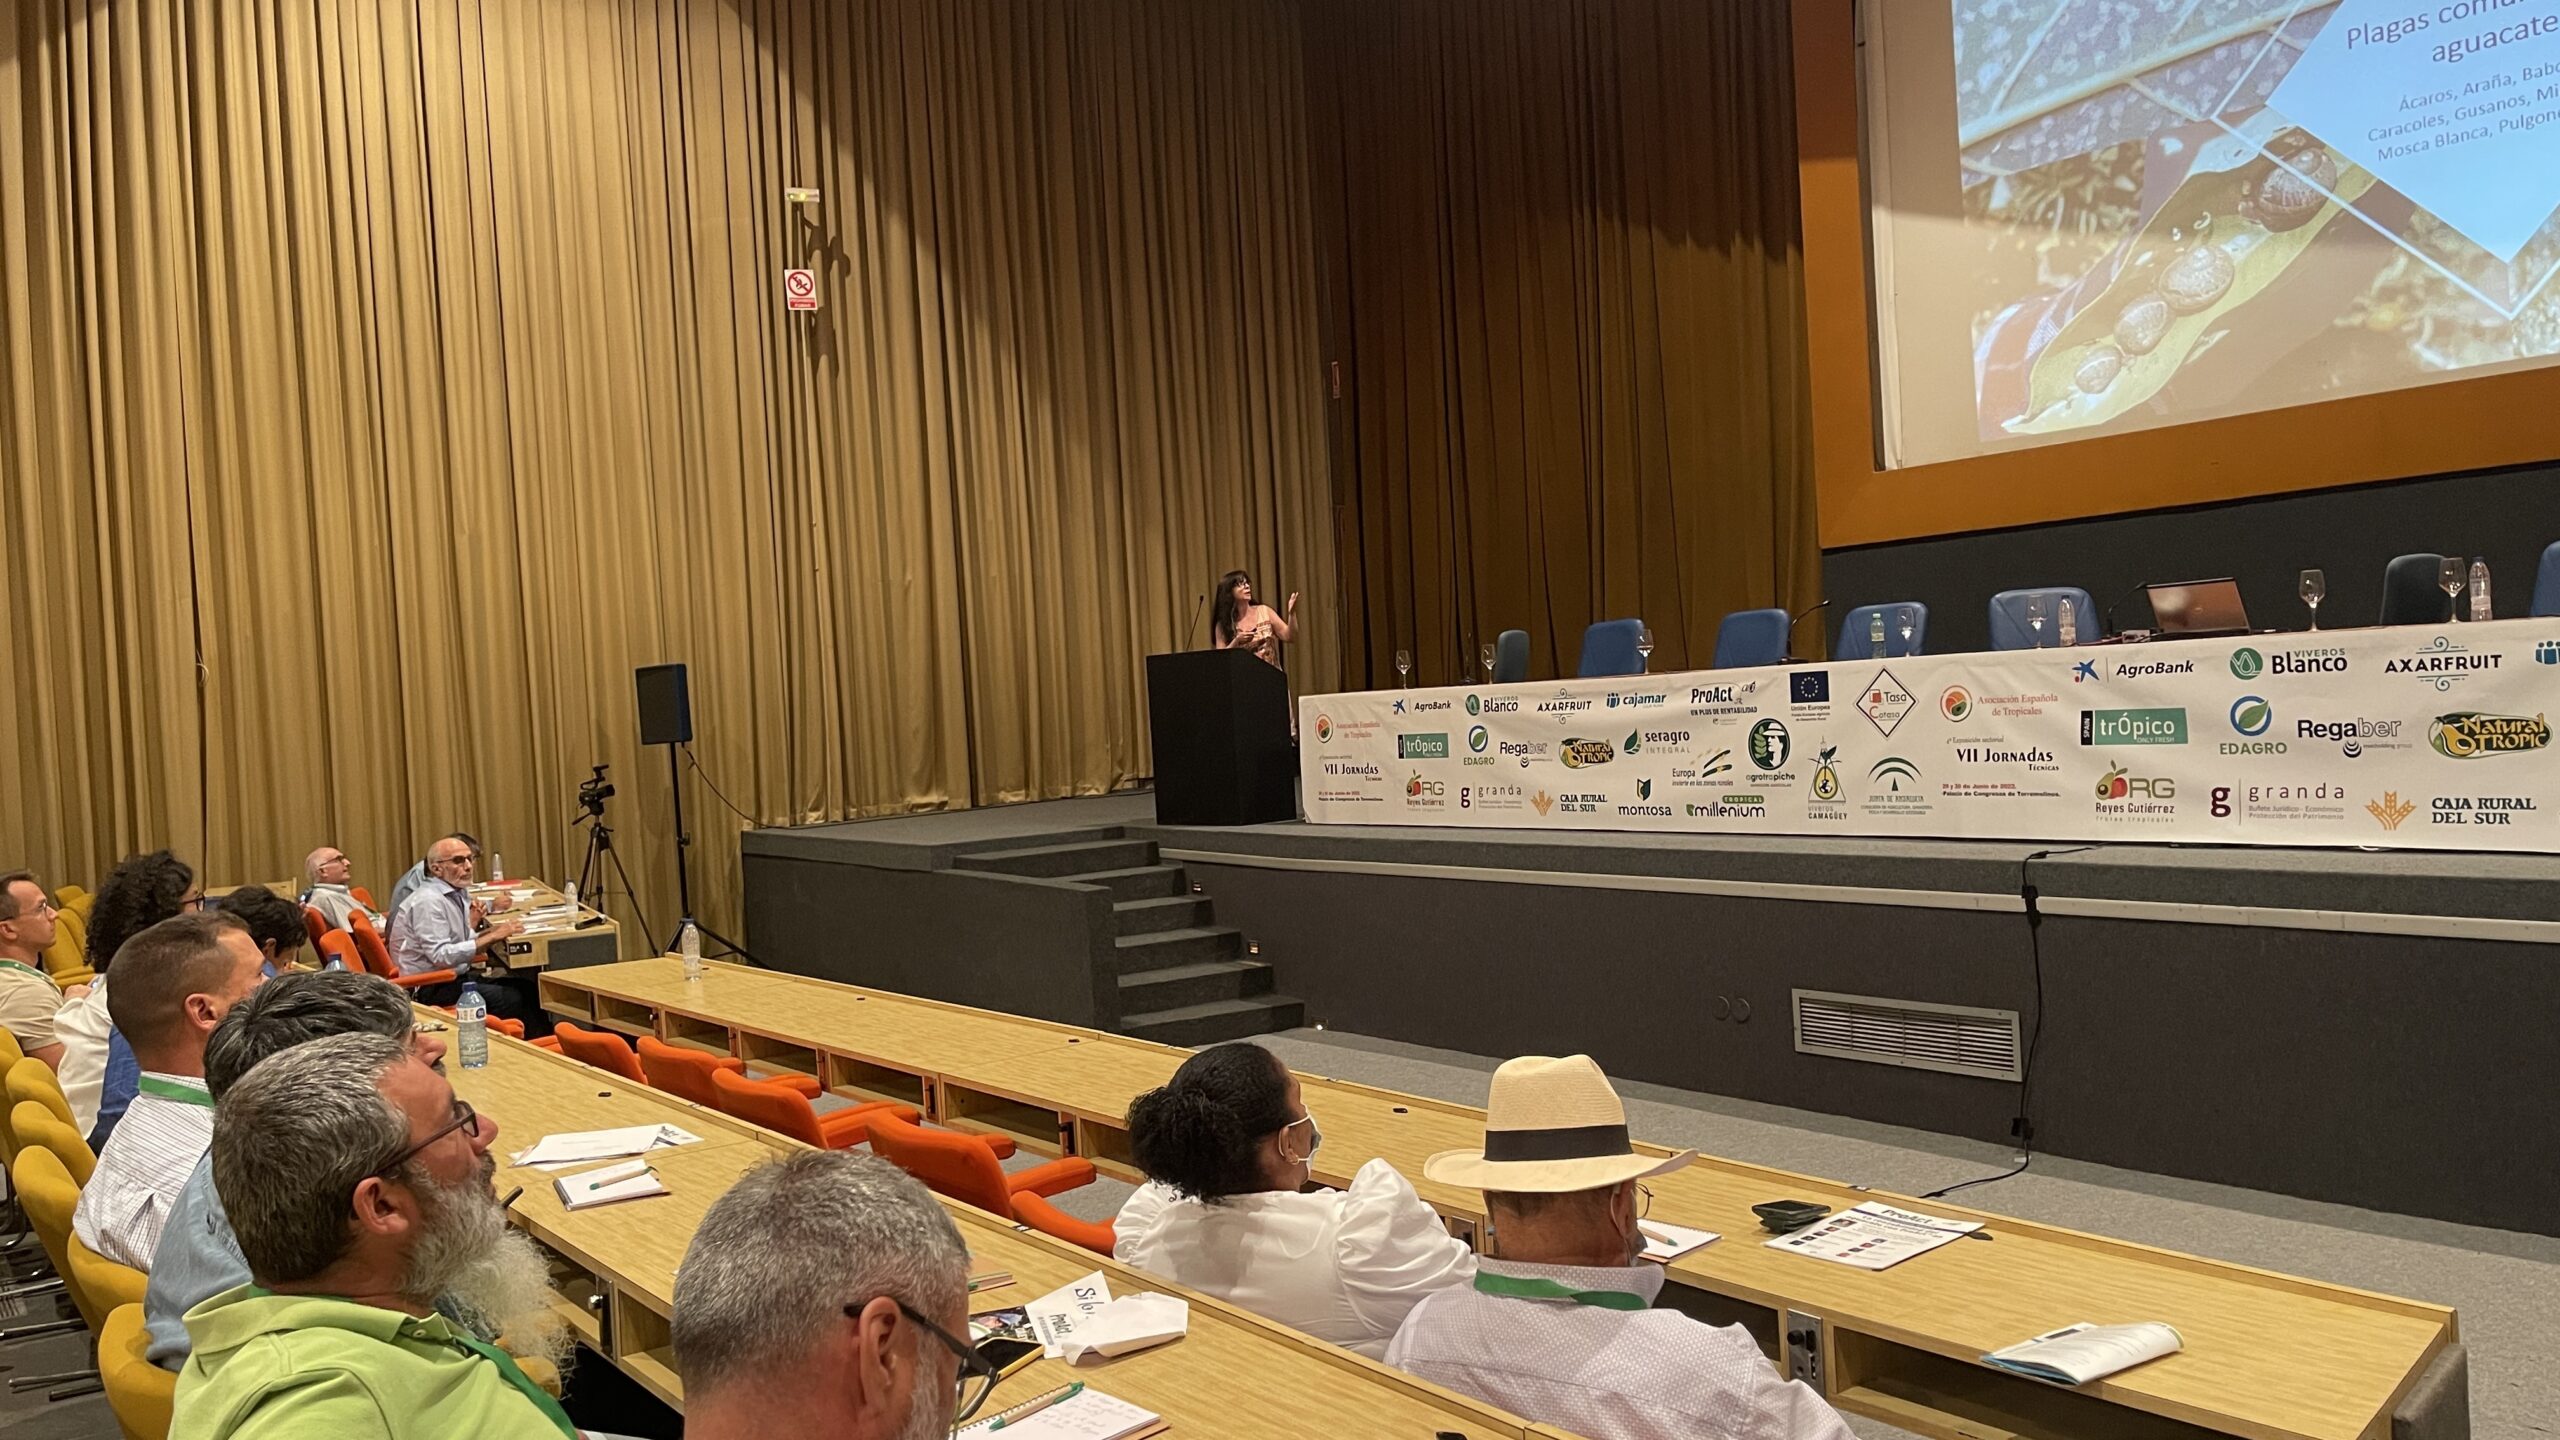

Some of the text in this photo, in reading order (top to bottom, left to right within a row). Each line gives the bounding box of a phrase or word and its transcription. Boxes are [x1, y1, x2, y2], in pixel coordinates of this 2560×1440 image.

[2346, 13, 2430, 50] Plagas
[2432, 14, 2559, 63] aguacate
[2399, 87, 2458, 112] Ácaros,
[2463, 73, 2517, 97] Araña,
[2367, 114, 2449, 142] Caracoles,
[2454, 95, 2531, 121] Gusanos,
[2377, 109, 2560, 162] Mosca Blanca, Pulgon
[2294, 648, 2346, 658] VIVEROS
[2116, 660, 2194, 679] AgroBank
[2272, 651, 2348, 674] Blanco
[2384, 654, 2502, 674] AXARFRUIT
[1622, 692, 1667, 708] cajamar
[1690, 686, 1733, 704] ProAct
[1883, 692, 1907, 702] Tasa
[1414, 700, 1451, 712] AgroBank
[1483, 697, 1519, 713] Blanco
[1537, 700, 1592, 712] AXARFRUIT
[2003, 707, 2042, 718] Tropicales
[2297, 717, 2402, 742] Regaber
[2460, 712, 2546, 735] Natural
[1645, 730, 1690, 746] seragro
[2474, 732, 2547, 753] TROPIC
[1500, 740, 1548, 757] Regaber
[1956, 748, 1978, 762] VII
[2219, 742, 2288, 755] EDAGRO
[1324, 764, 1338, 775] VII
[1464, 757, 1495, 766] EDAGRO
[1672, 768, 1696, 778] Europa
[1422, 781, 1445, 796] RG
[1478, 784, 1522, 798] granda
[2128, 778, 2176, 799] RG
[2248, 782, 2345, 802] granda
[1560, 794, 1608, 803] CAJA RURAL
[2210, 786, 2231, 818] g
[2432, 798, 2536, 811] CAJA RURAL
[1561, 804, 1596, 812] DEL SUR
[1618, 804, 1672, 816] montosa
[1694, 802, 1766, 818] millenium
[1808, 812, 1848, 820] CAMAGÜEY
[2096, 802, 2175, 815] Reyes Gutiérrez
[2432, 812, 2510, 824] DEL SUR
